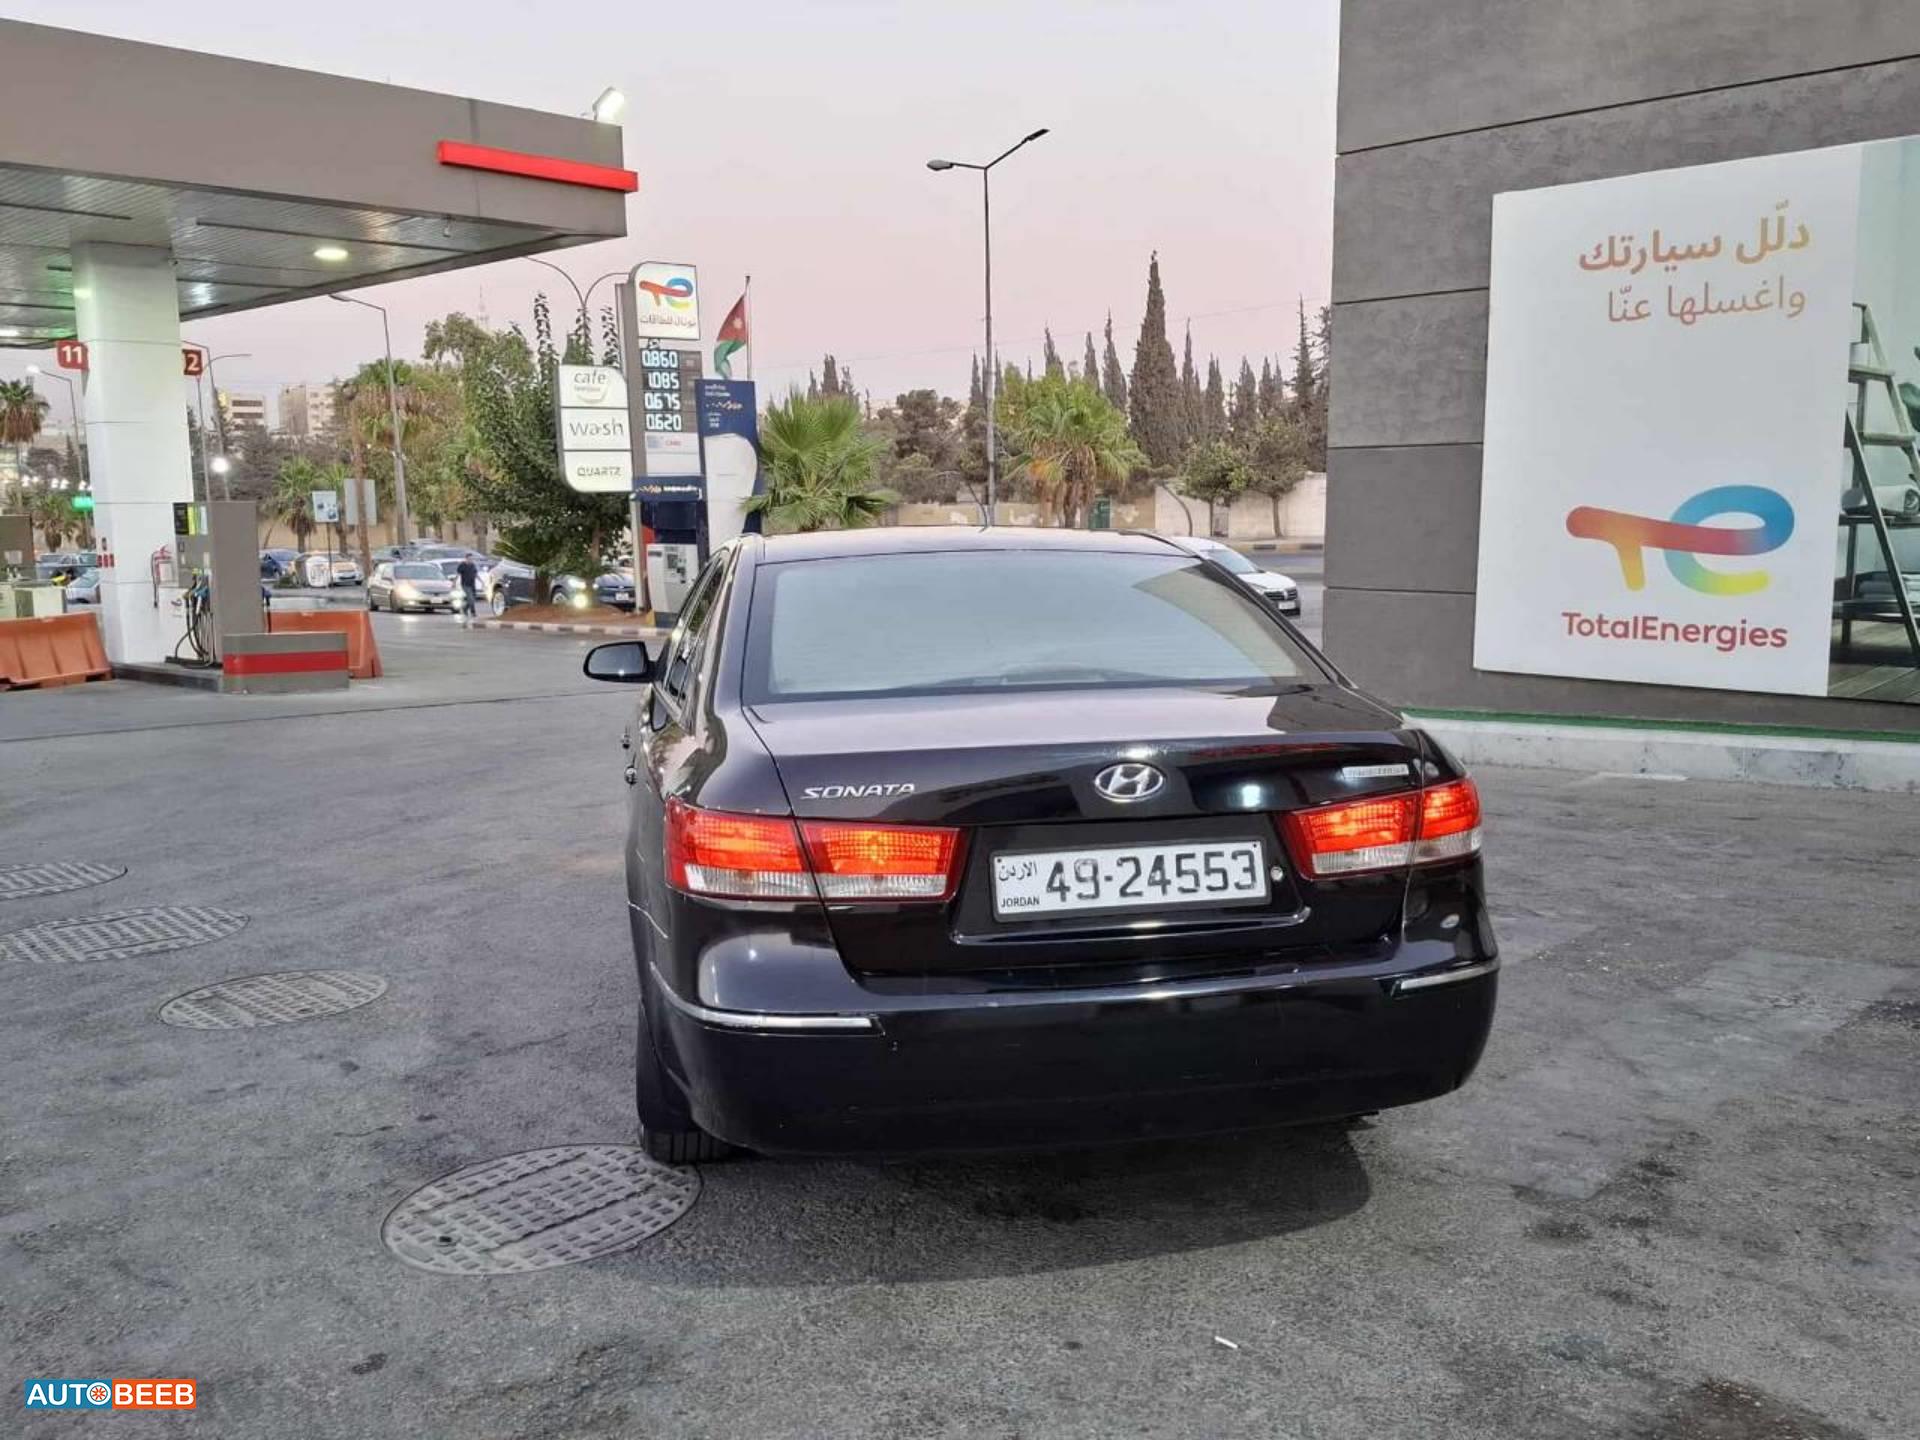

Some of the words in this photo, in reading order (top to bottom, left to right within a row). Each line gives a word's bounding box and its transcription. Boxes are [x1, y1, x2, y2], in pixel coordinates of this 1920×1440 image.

[1578, 229, 1722, 275] سيارتك
[1667, 274, 1806, 326] واغسلها
[62, 346, 83, 364] 11
[569, 417, 624, 437] wash
[1561, 611, 1789, 652] TotalEnergies
[800, 783, 915, 799] SONATA
[1045, 849, 1258, 903] 49-24553
[1000, 895, 1041, 908] JORDAN
